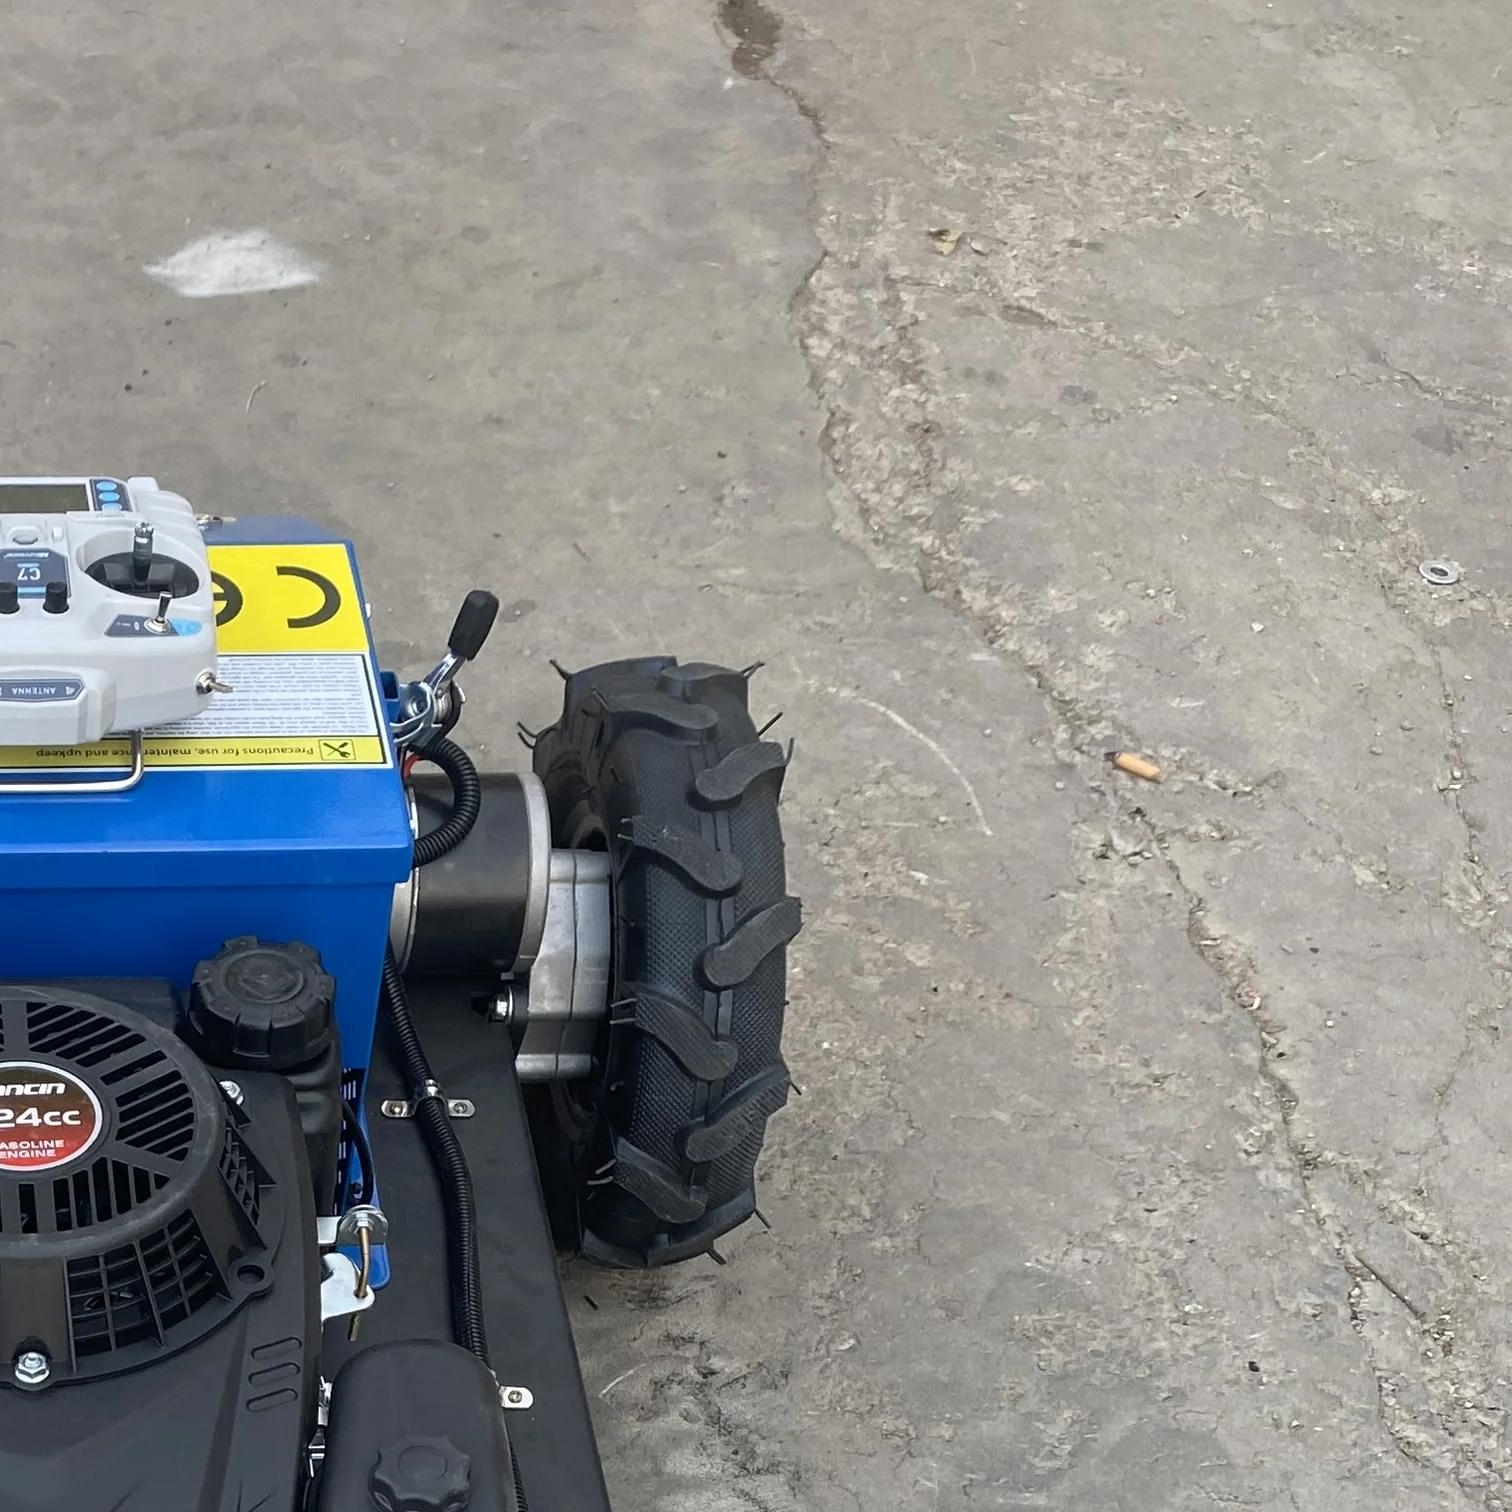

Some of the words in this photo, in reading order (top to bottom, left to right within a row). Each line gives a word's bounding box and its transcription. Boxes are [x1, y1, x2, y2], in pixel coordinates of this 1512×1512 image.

[17, 567, 41, 581] C7
[12, 687, 56, 695] ANTENNA
[36, 749, 81, 757] upkeep
[85, 749, 109, 757] and
[194, 747, 219, 755] use,
[222, 748, 240, 756] for
[242, 747, 314, 755] Precautions
